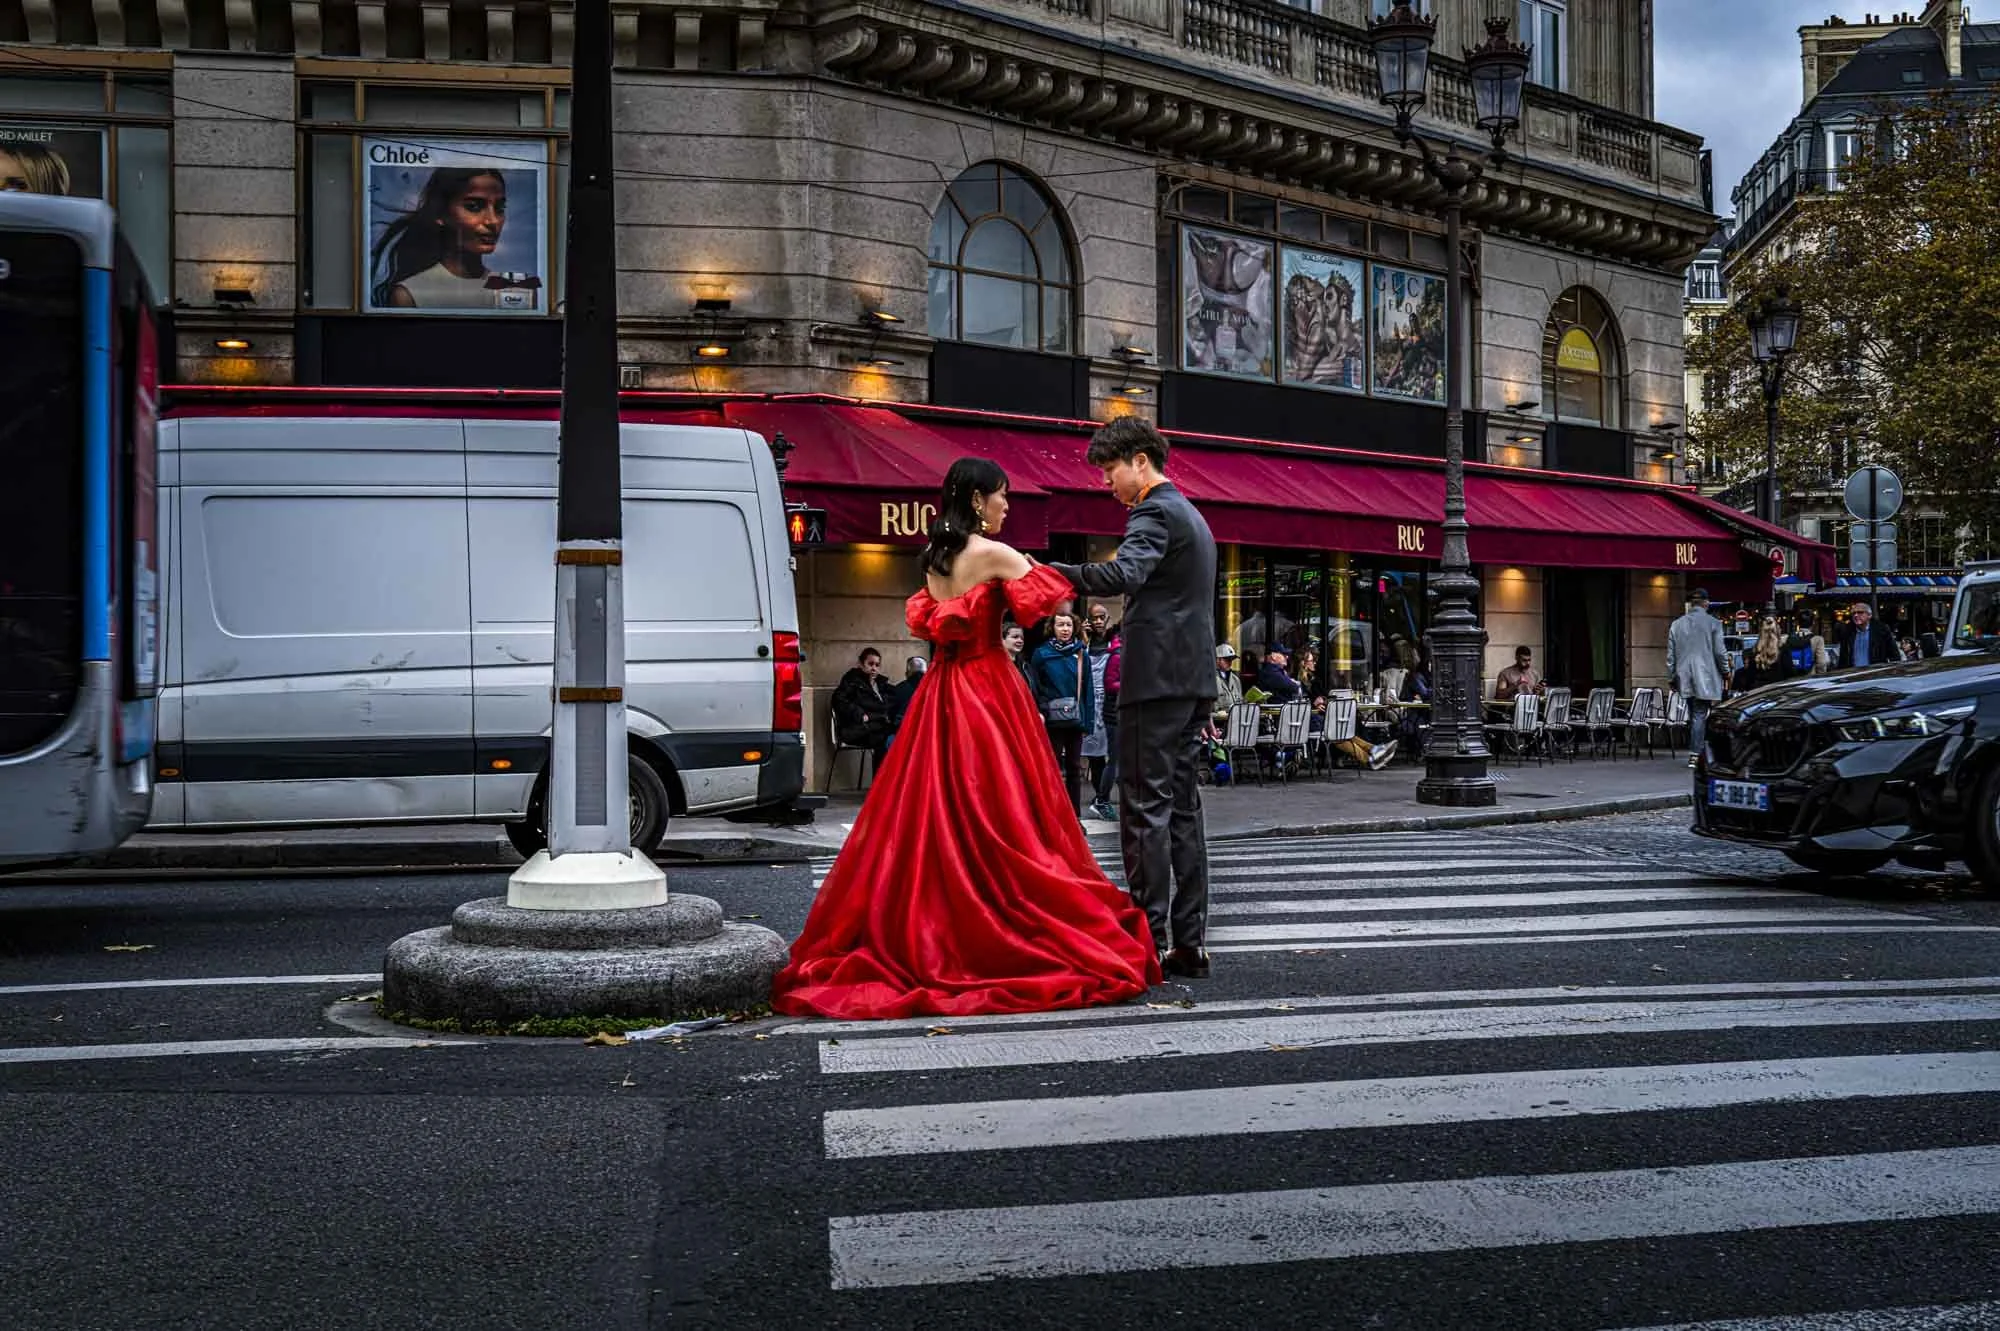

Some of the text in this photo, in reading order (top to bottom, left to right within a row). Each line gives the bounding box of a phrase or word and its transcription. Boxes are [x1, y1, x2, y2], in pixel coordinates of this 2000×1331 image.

[17, 130, 53, 142] MILLET
[369, 144, 429, 164] Chloé
[880, 501, 937, 536] RUC
[1397, 524, 1425, 551] RUC
[1675, 542, 1697, 565] RUC
